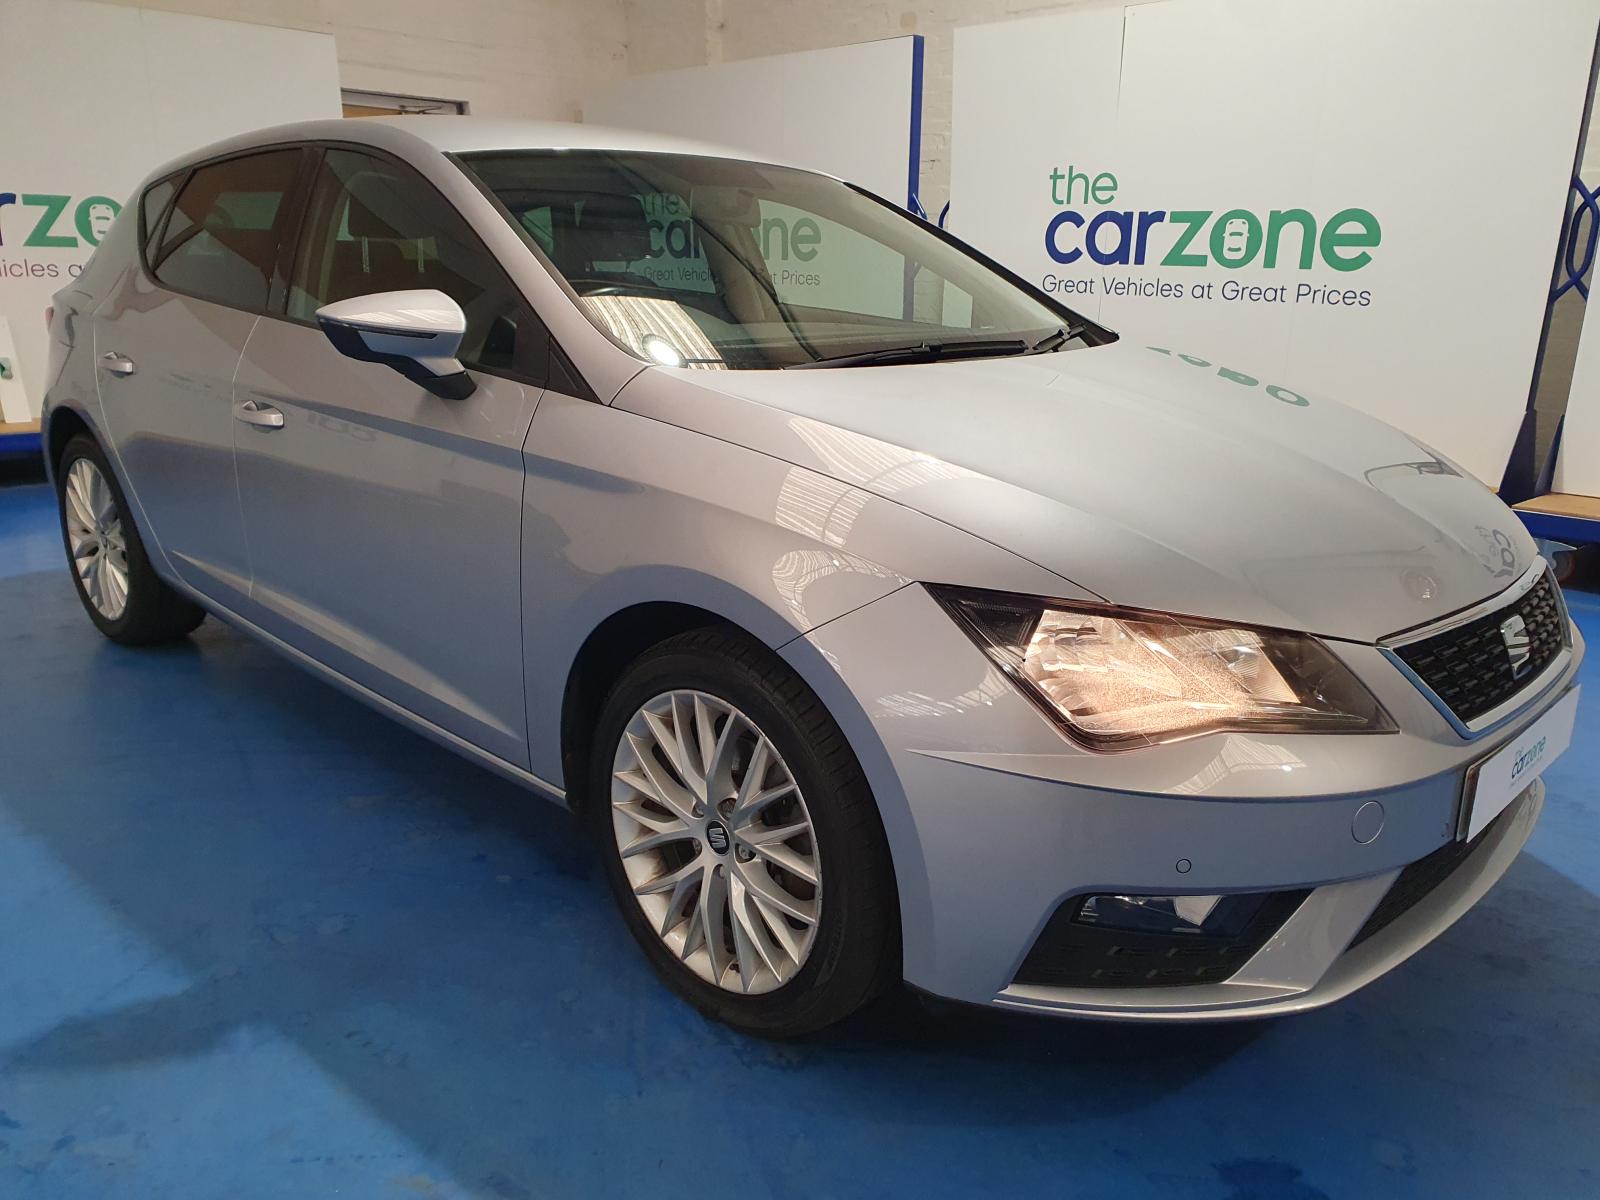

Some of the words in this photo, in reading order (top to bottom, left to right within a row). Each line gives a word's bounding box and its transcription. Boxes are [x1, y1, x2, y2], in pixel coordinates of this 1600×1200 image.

[1049, 166, 1118, 205] the
[1045, 208, 1382, 272] carzone
[0, 259, 60, 278] icles
[781, 269, 821, 286] Prices
[1042, 274, 1095, 295] Great
[1102, 276, 1184, 298] Vehicles
[1191, 282, 1213, 300] at
[1221, 280, 1287, 303] Great
[1295, 283, 1372, 307] Prices
